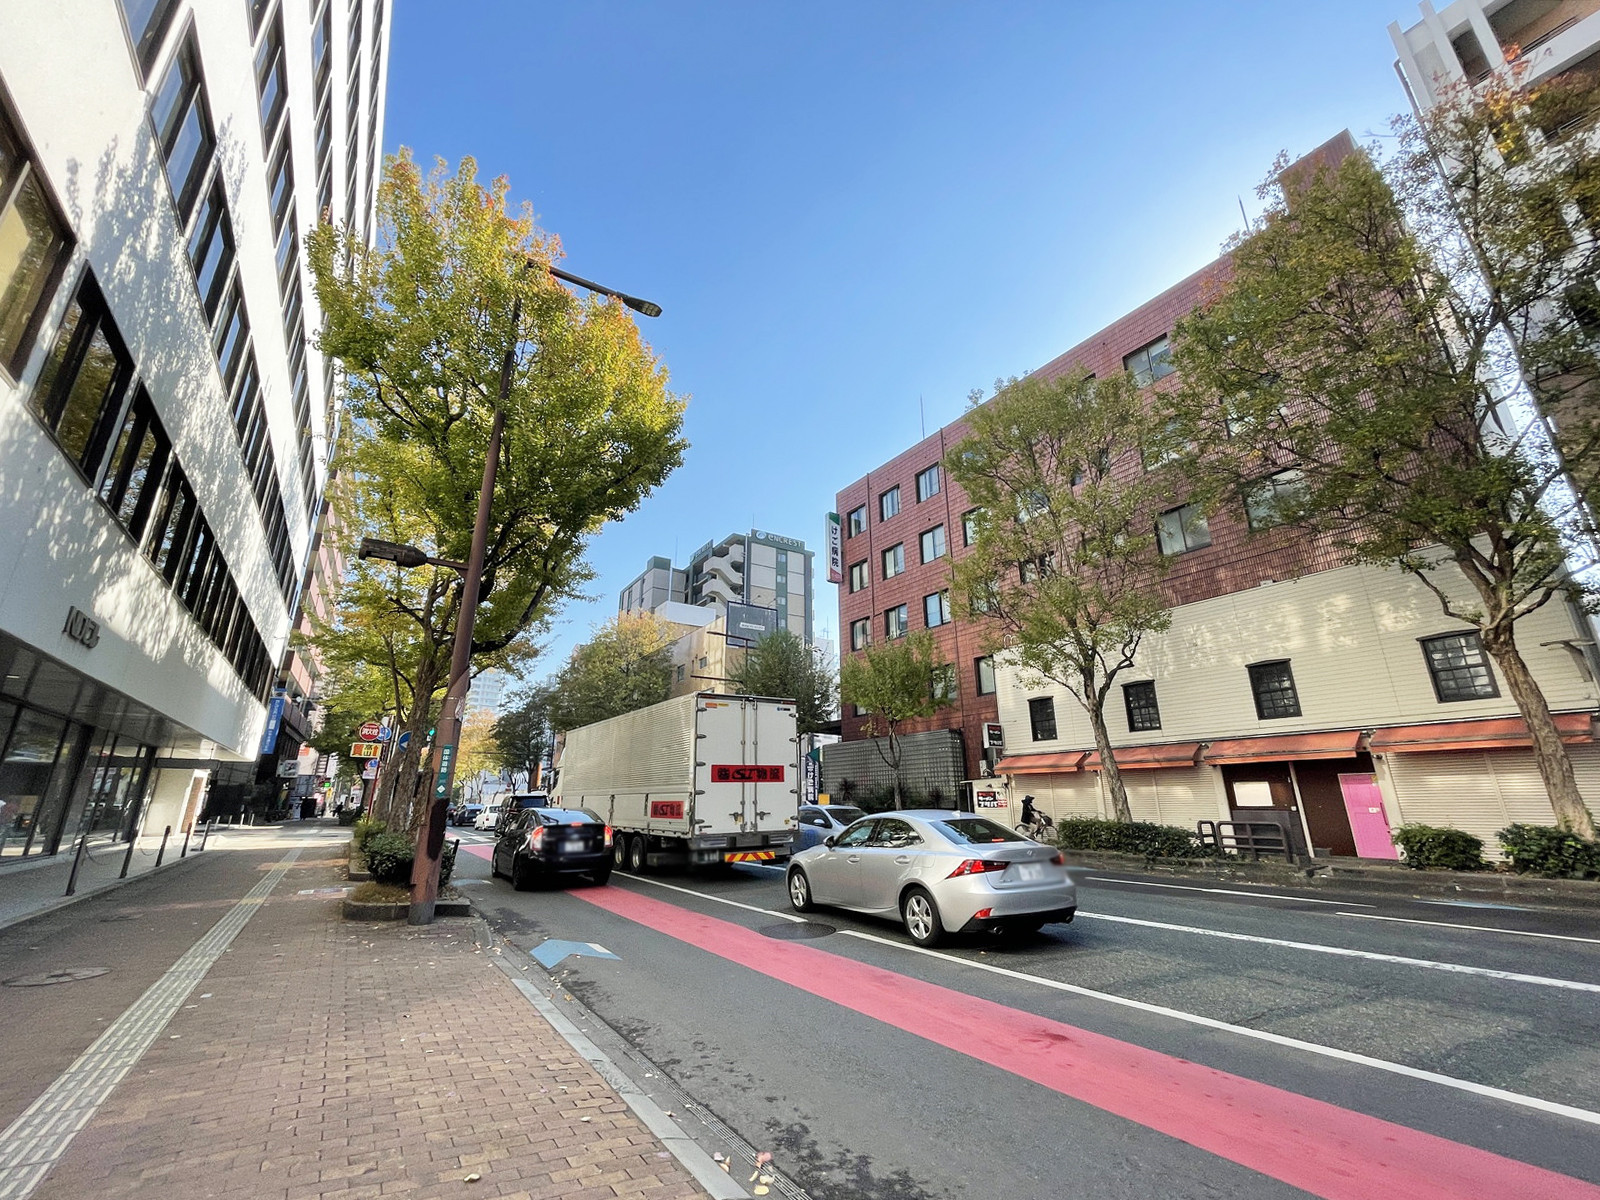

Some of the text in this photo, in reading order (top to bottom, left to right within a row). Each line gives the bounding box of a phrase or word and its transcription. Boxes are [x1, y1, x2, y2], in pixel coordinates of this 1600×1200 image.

[831, 526, 839, 567] けご病院
[441, 749, 450, 773] 国体道路
